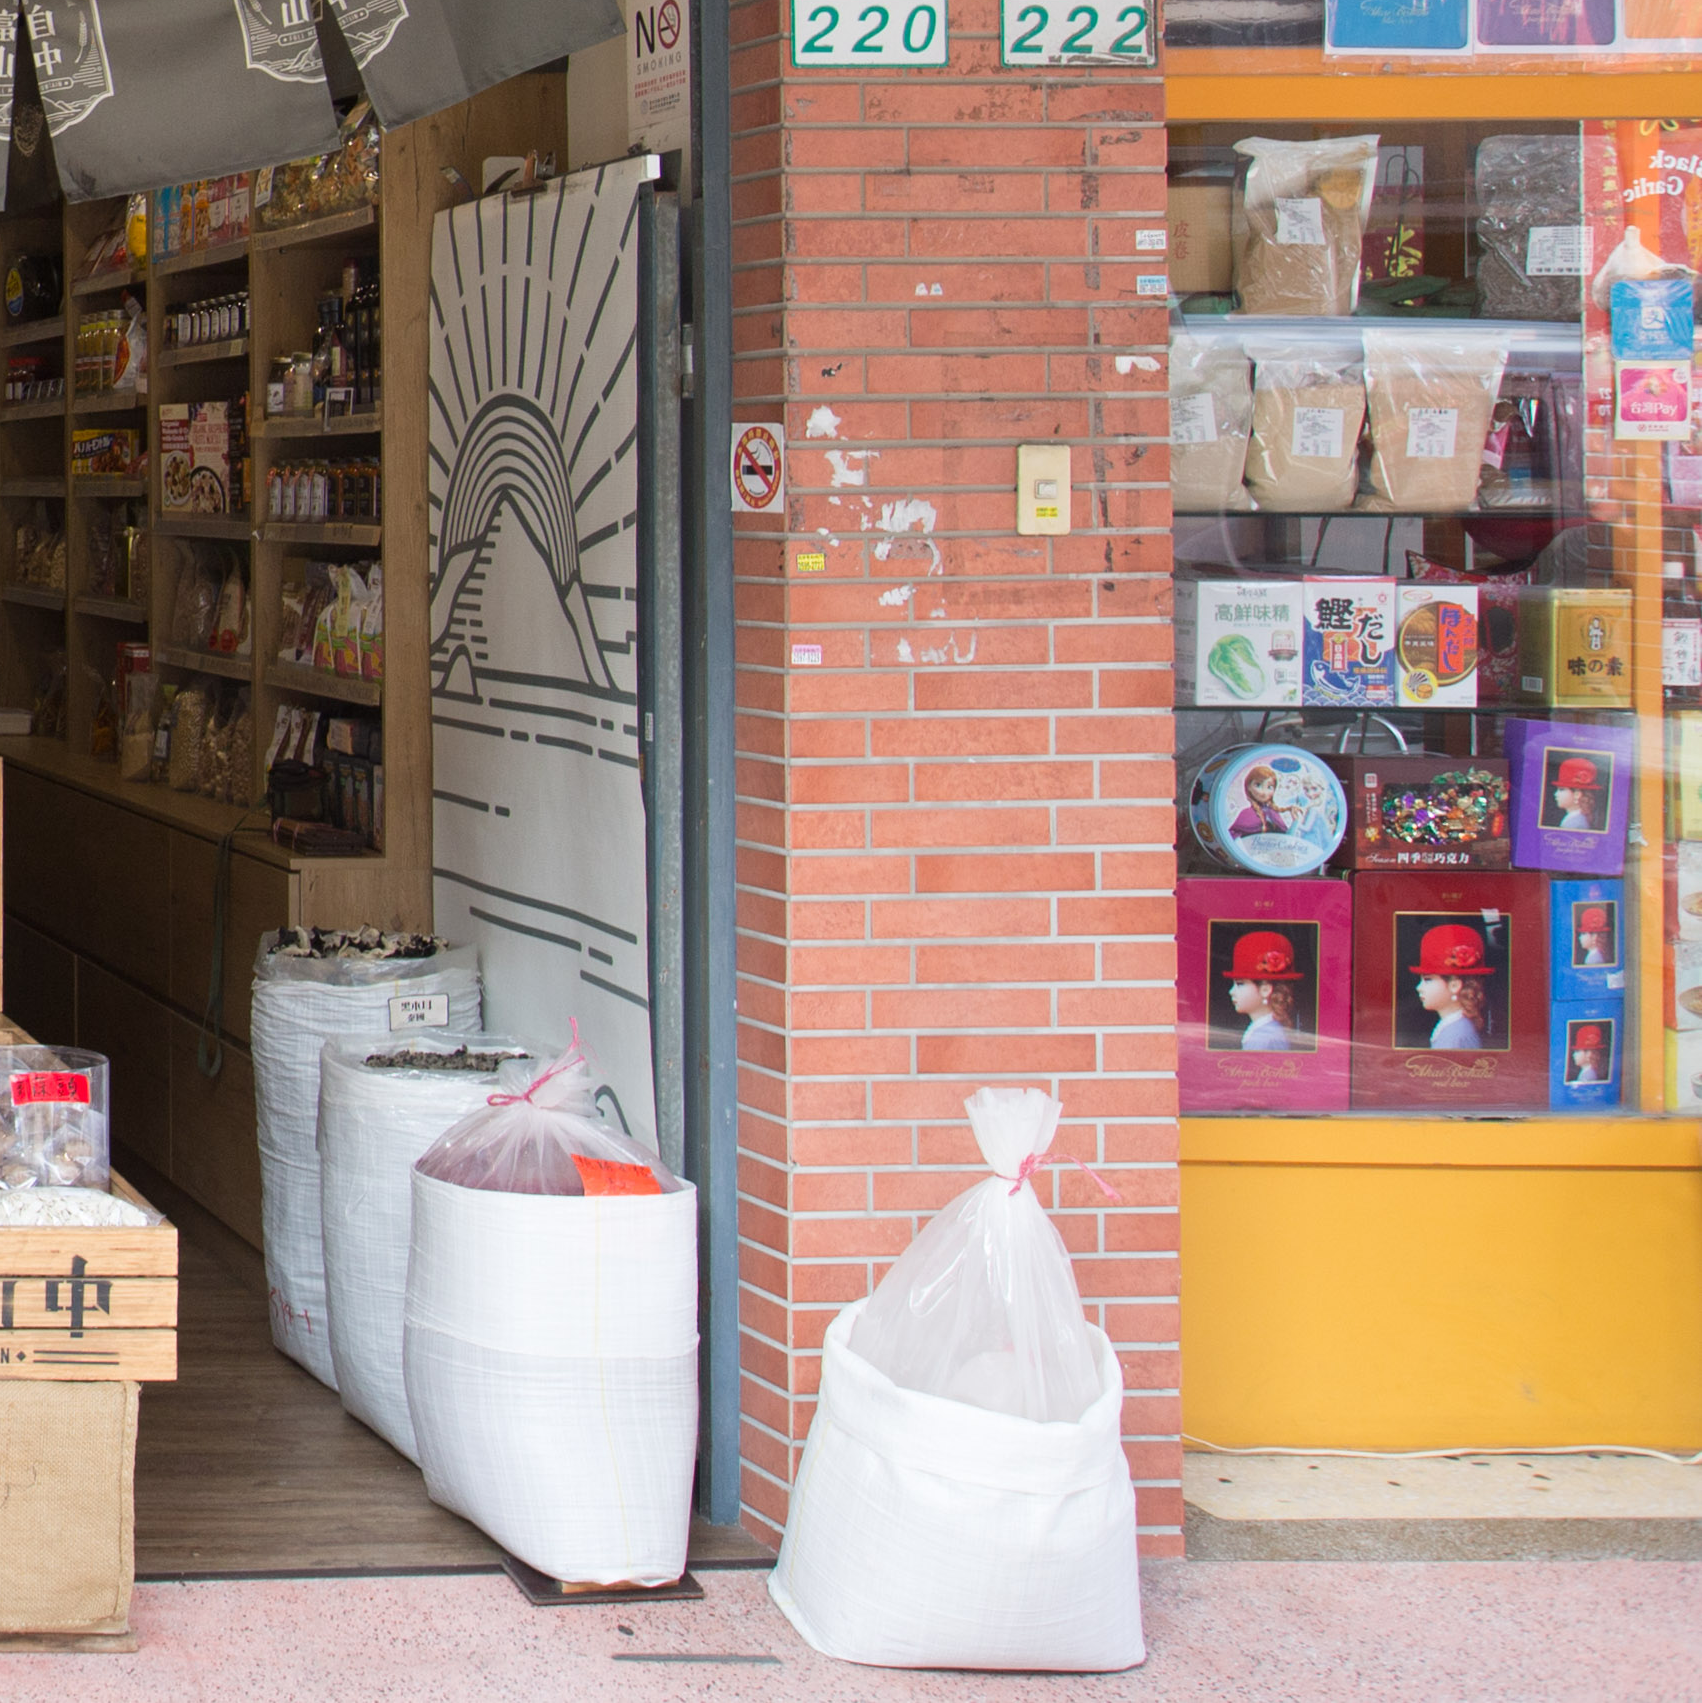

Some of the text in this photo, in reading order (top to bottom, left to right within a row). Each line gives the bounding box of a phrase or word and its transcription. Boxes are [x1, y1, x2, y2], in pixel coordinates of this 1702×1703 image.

[801, 5, 936, 54] 220
[1011, 5, 1147, 54] 222
[636, 52, 682, 75] SMOKING
[1630, 401, 1679, 418] 台灣Pay
[1214, 602, 1292, 623] 高鮮味精
[1440, 607, 1462, 673] ほんだし
[1568, 657, 1626, 678] 味の素
